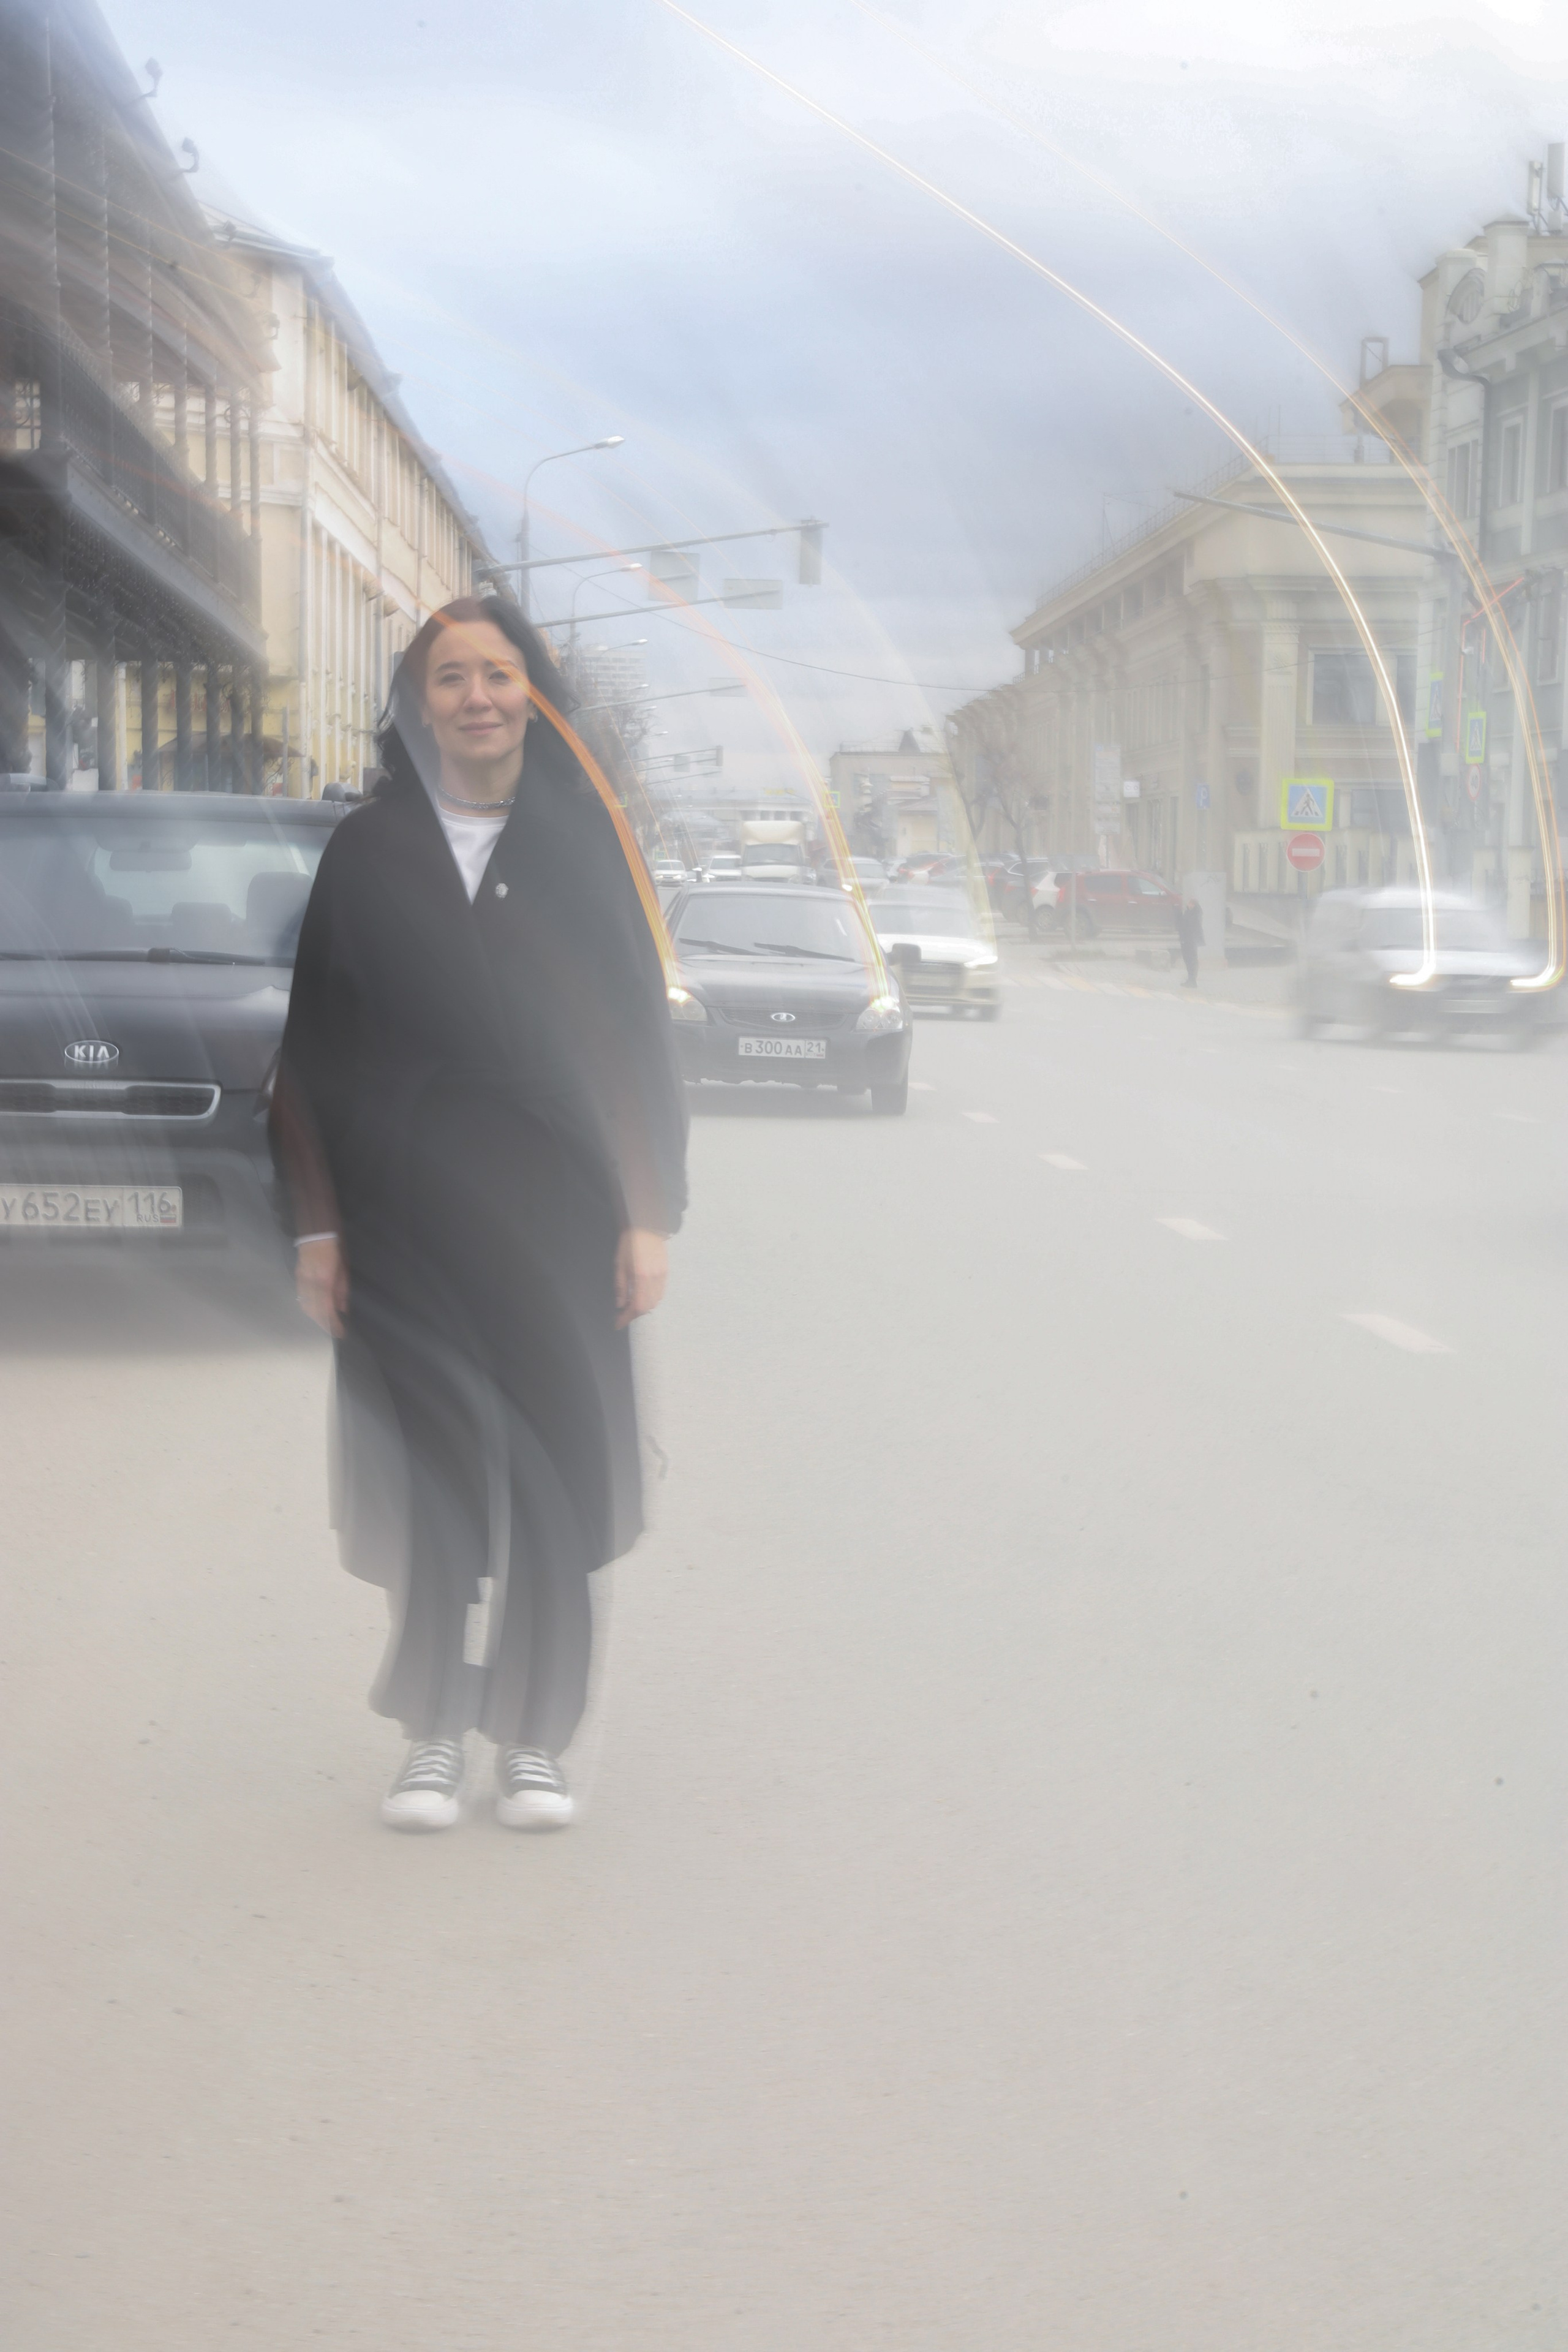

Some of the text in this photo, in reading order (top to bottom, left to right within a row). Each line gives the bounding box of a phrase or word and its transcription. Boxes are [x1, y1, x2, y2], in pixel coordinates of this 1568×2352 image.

[74, 1045, 110, 1058] KIA
[807, 1042, 821, 1053] 21
[127, 1191, 172, 1214] 116
[136, 1214, 159, 1223] RUS
